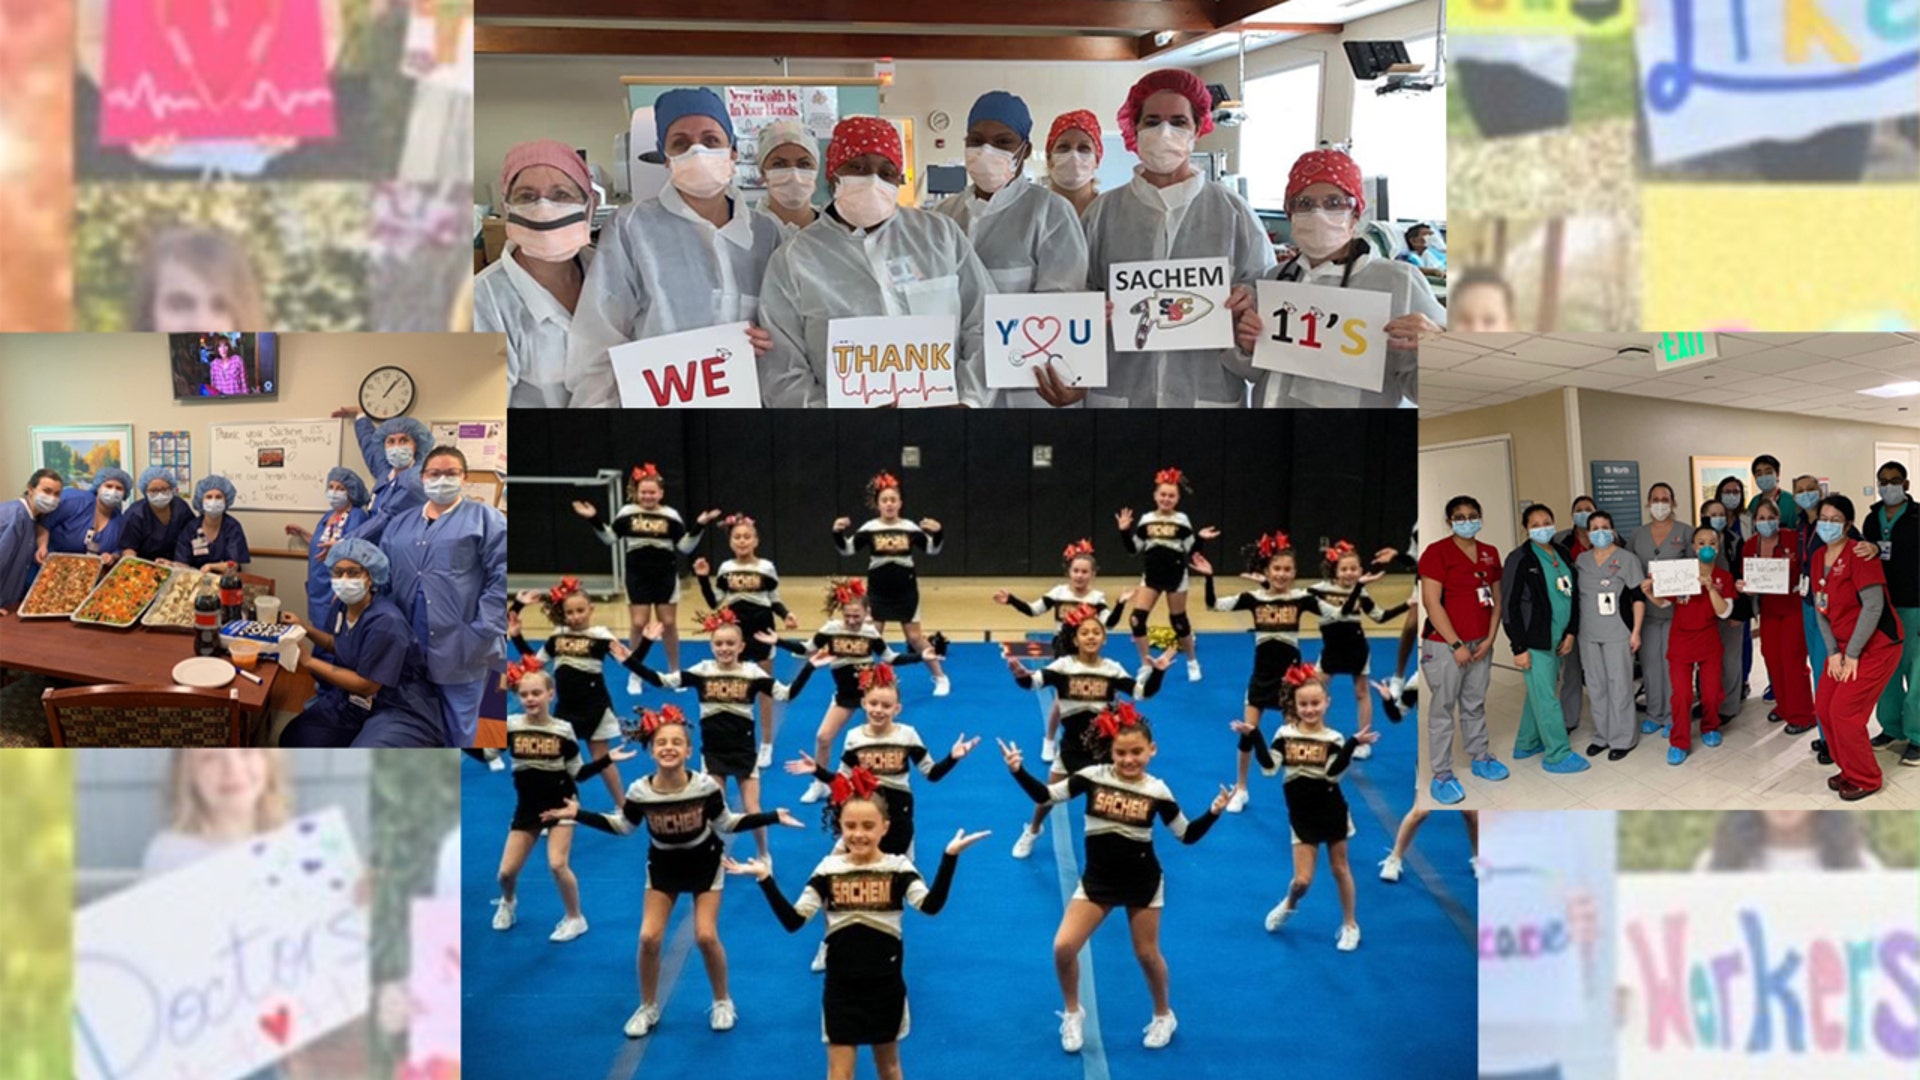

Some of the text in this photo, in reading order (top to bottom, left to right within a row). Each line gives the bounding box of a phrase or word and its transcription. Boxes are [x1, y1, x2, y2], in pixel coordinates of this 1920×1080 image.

[1115, 265, 1224, 291] SACHEM
[832, 342, 952, 374] THANK
[642, 354, 730, 407] WE
[705, 682, 749, 698] SACHEM
[513, 734, 561, 754] SACHEM
[1093, 792, 1149, 820] SACHEM
[832, 880, 891, 903] SACHEM
[1625, 909, 1920, 1059] Workers
